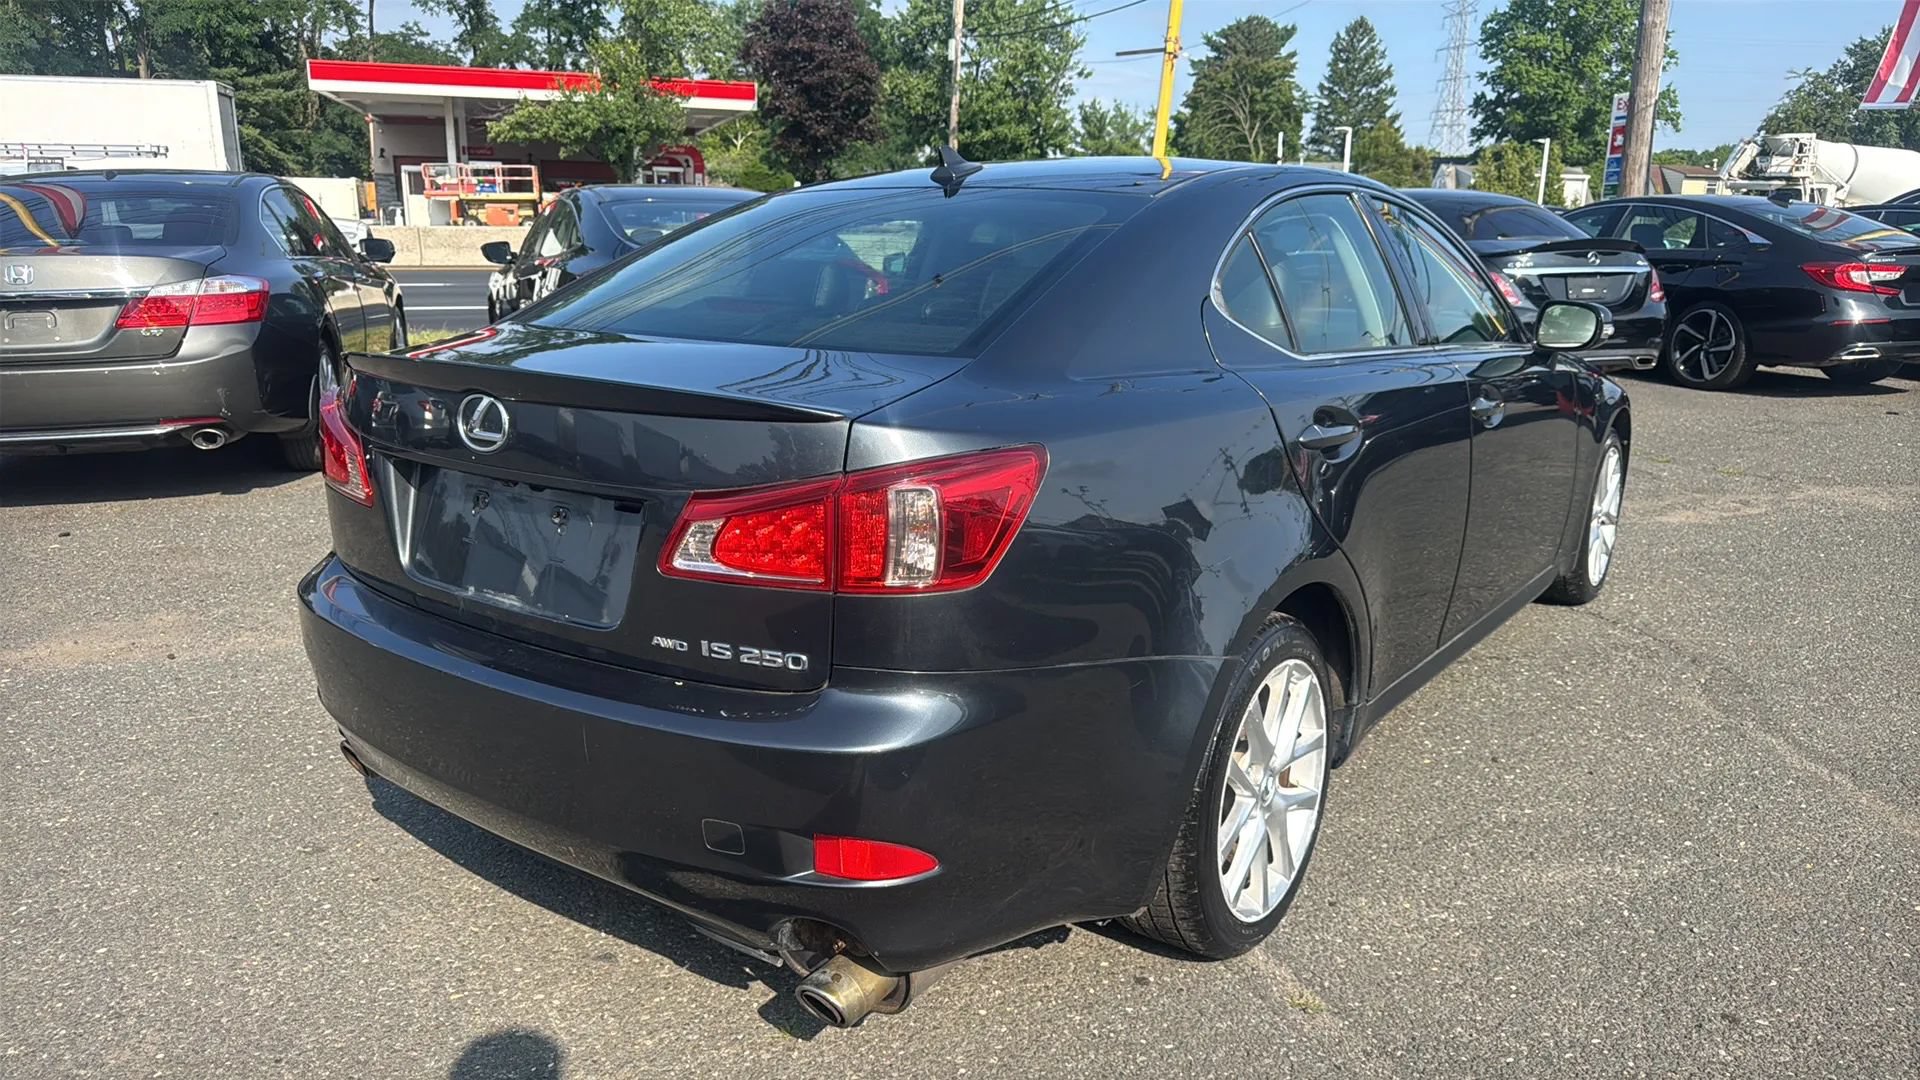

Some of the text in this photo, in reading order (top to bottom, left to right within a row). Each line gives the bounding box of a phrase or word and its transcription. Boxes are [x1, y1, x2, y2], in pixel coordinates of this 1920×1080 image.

[651, 635, 808, 671] AWD IS 250
